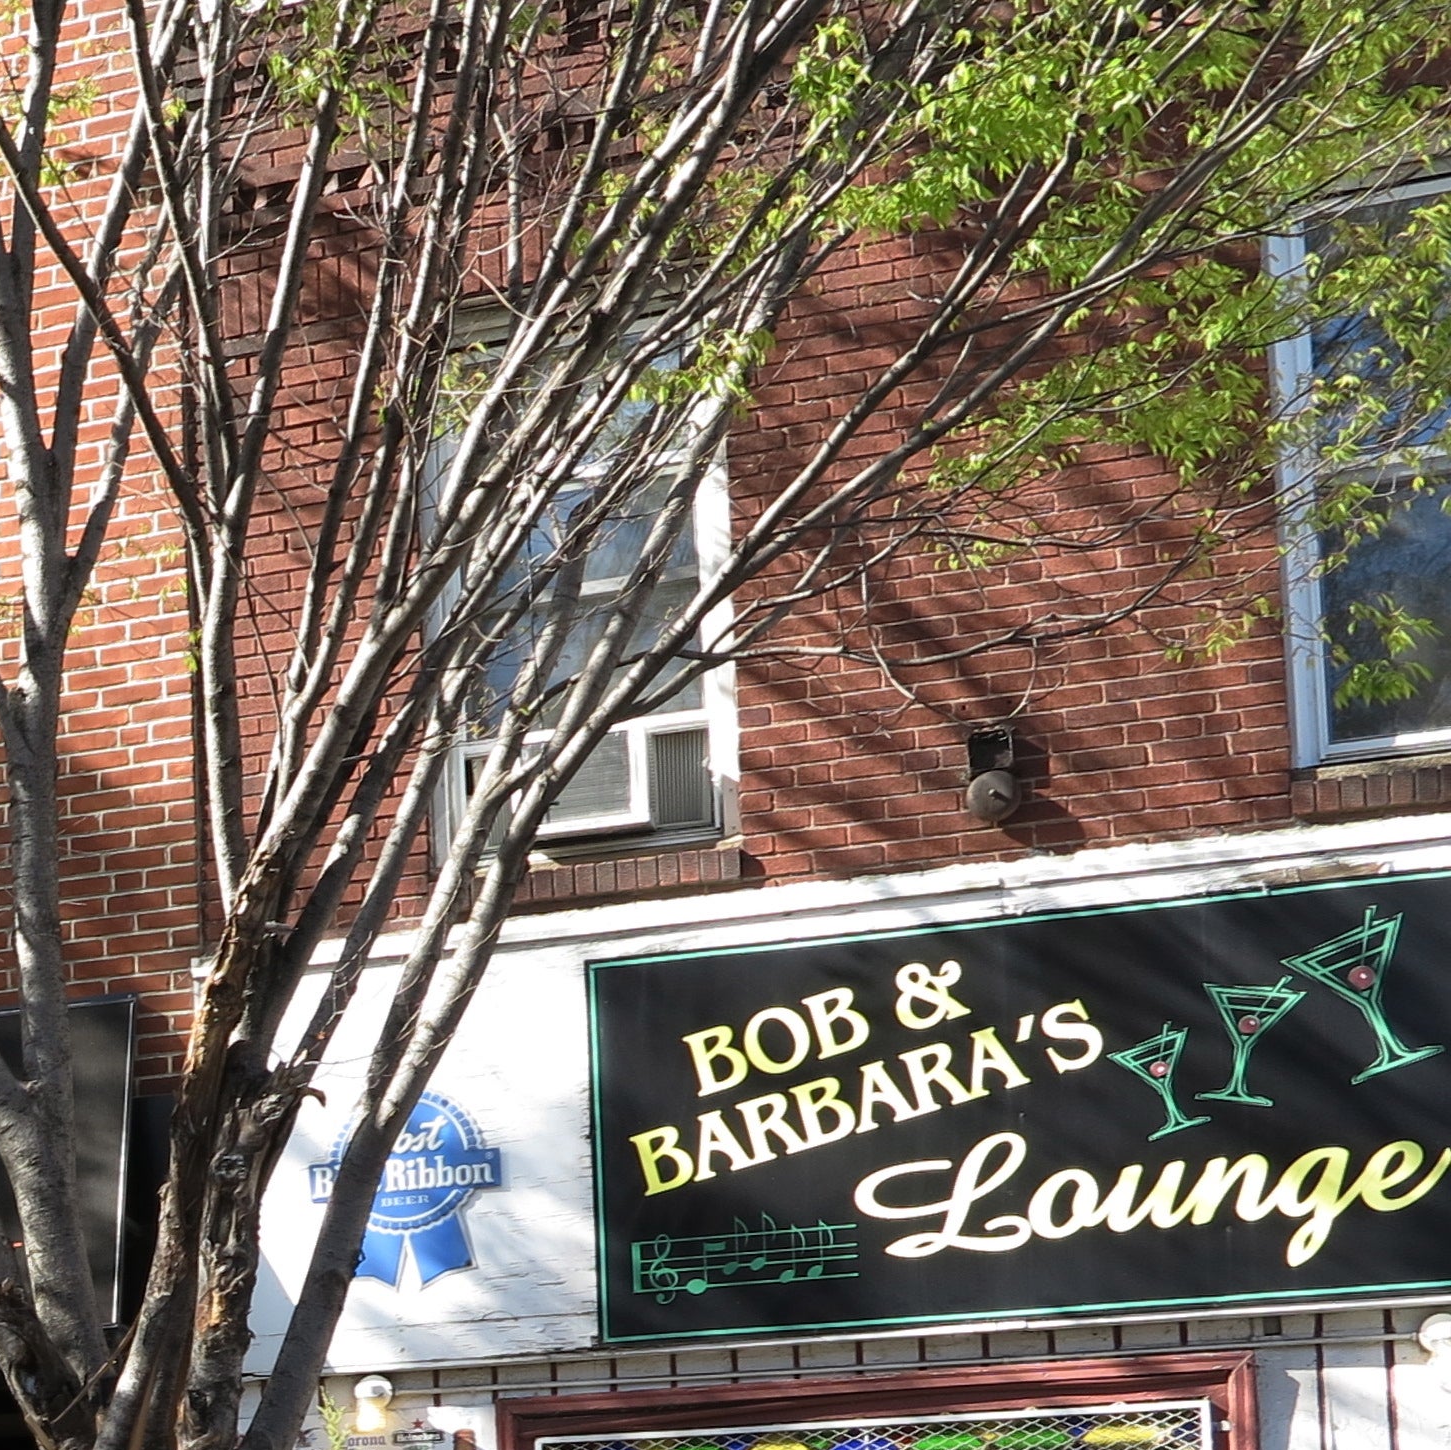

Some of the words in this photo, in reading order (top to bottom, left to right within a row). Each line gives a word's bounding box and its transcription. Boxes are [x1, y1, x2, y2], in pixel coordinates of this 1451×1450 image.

[681, 986, 871, 1098] BOB
[894, 959, 972, 1031] &
[628, 997, 1104, 1198] BARBARA'S
[380, 1194, 431, 1208] BEER
[384, 1154, 495, 1194] Ribbon
[853, 1131, 1451, 1268] Lounge
[347, 1435, 386, 1447] orona
